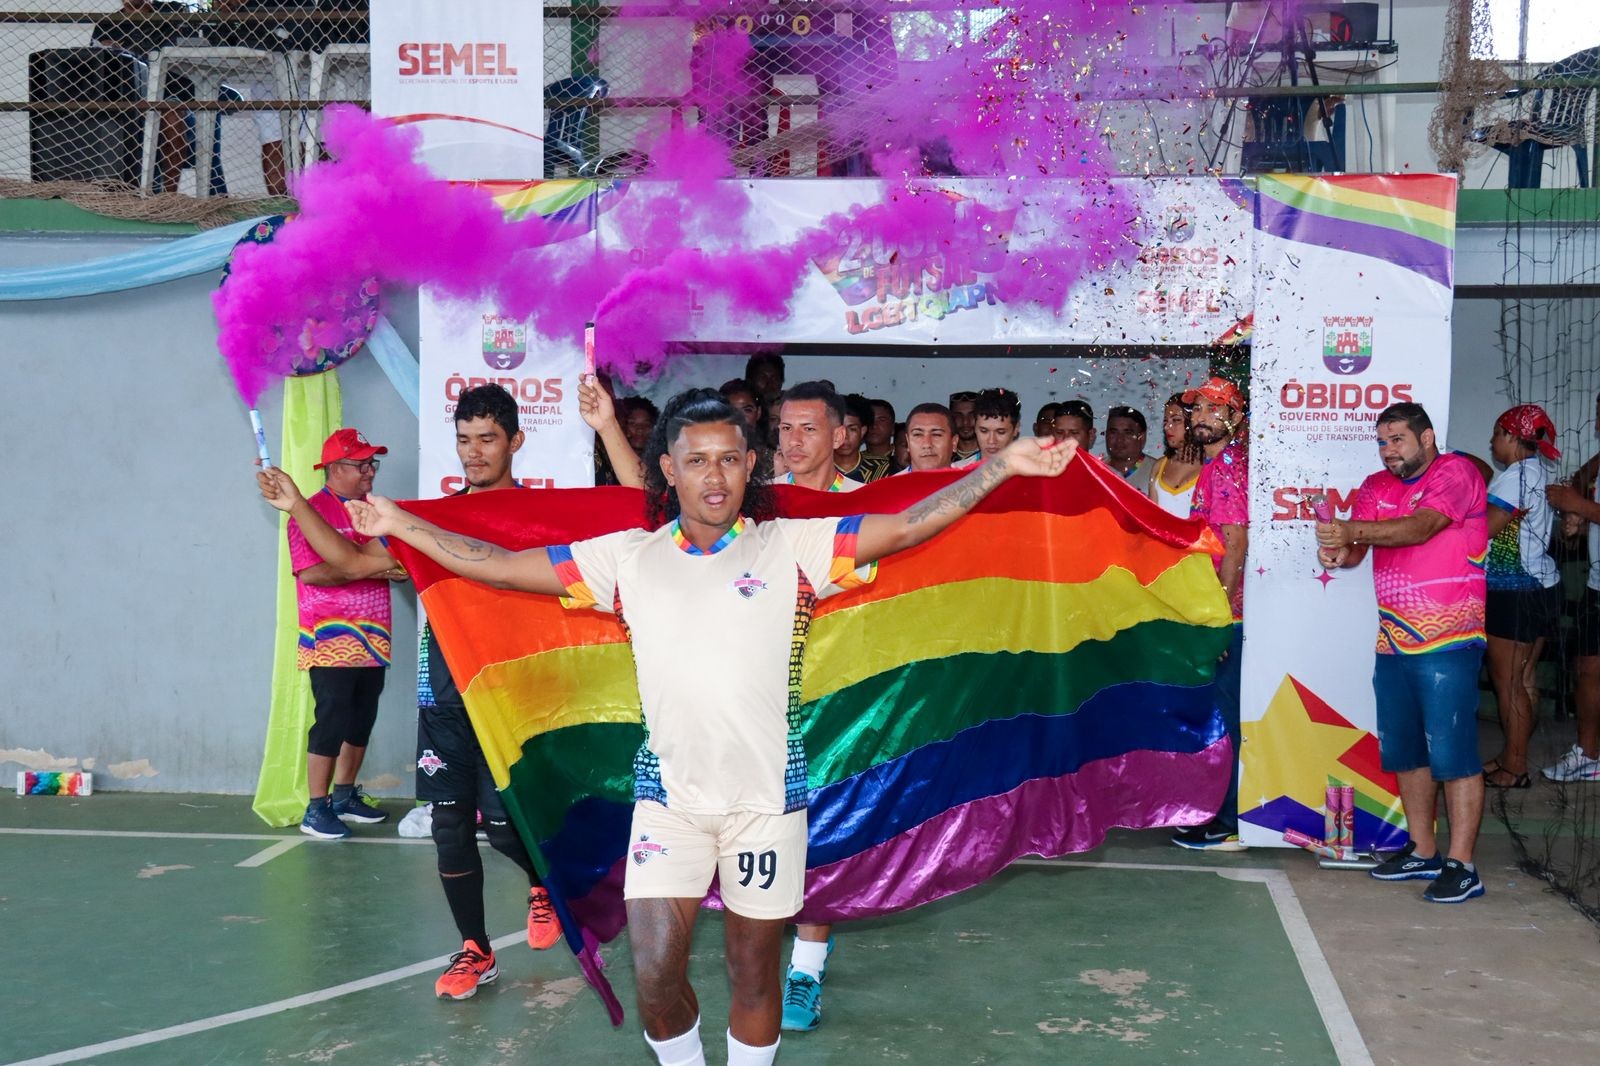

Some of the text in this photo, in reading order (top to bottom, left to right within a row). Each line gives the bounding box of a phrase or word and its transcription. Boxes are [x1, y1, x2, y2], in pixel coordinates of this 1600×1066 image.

[398, 43, 518, 75] SEMEL
[445, 373, 563, 402] ÓDOS
[1280, 378, 1413, 410] ÓBIDOS
[518, 406, 562, 415] NICIPAL
[1279, 411, 1339, 421] GOVERNO
[523, 418, 563, 426] TRABALHO
[1320, 424, 1331, 432] DE
[1306, 433, 1377, 441] QUE TRANSFORM
[1272, 487, 1361, 521] SEM
[738, 849, 777, 890] 99
